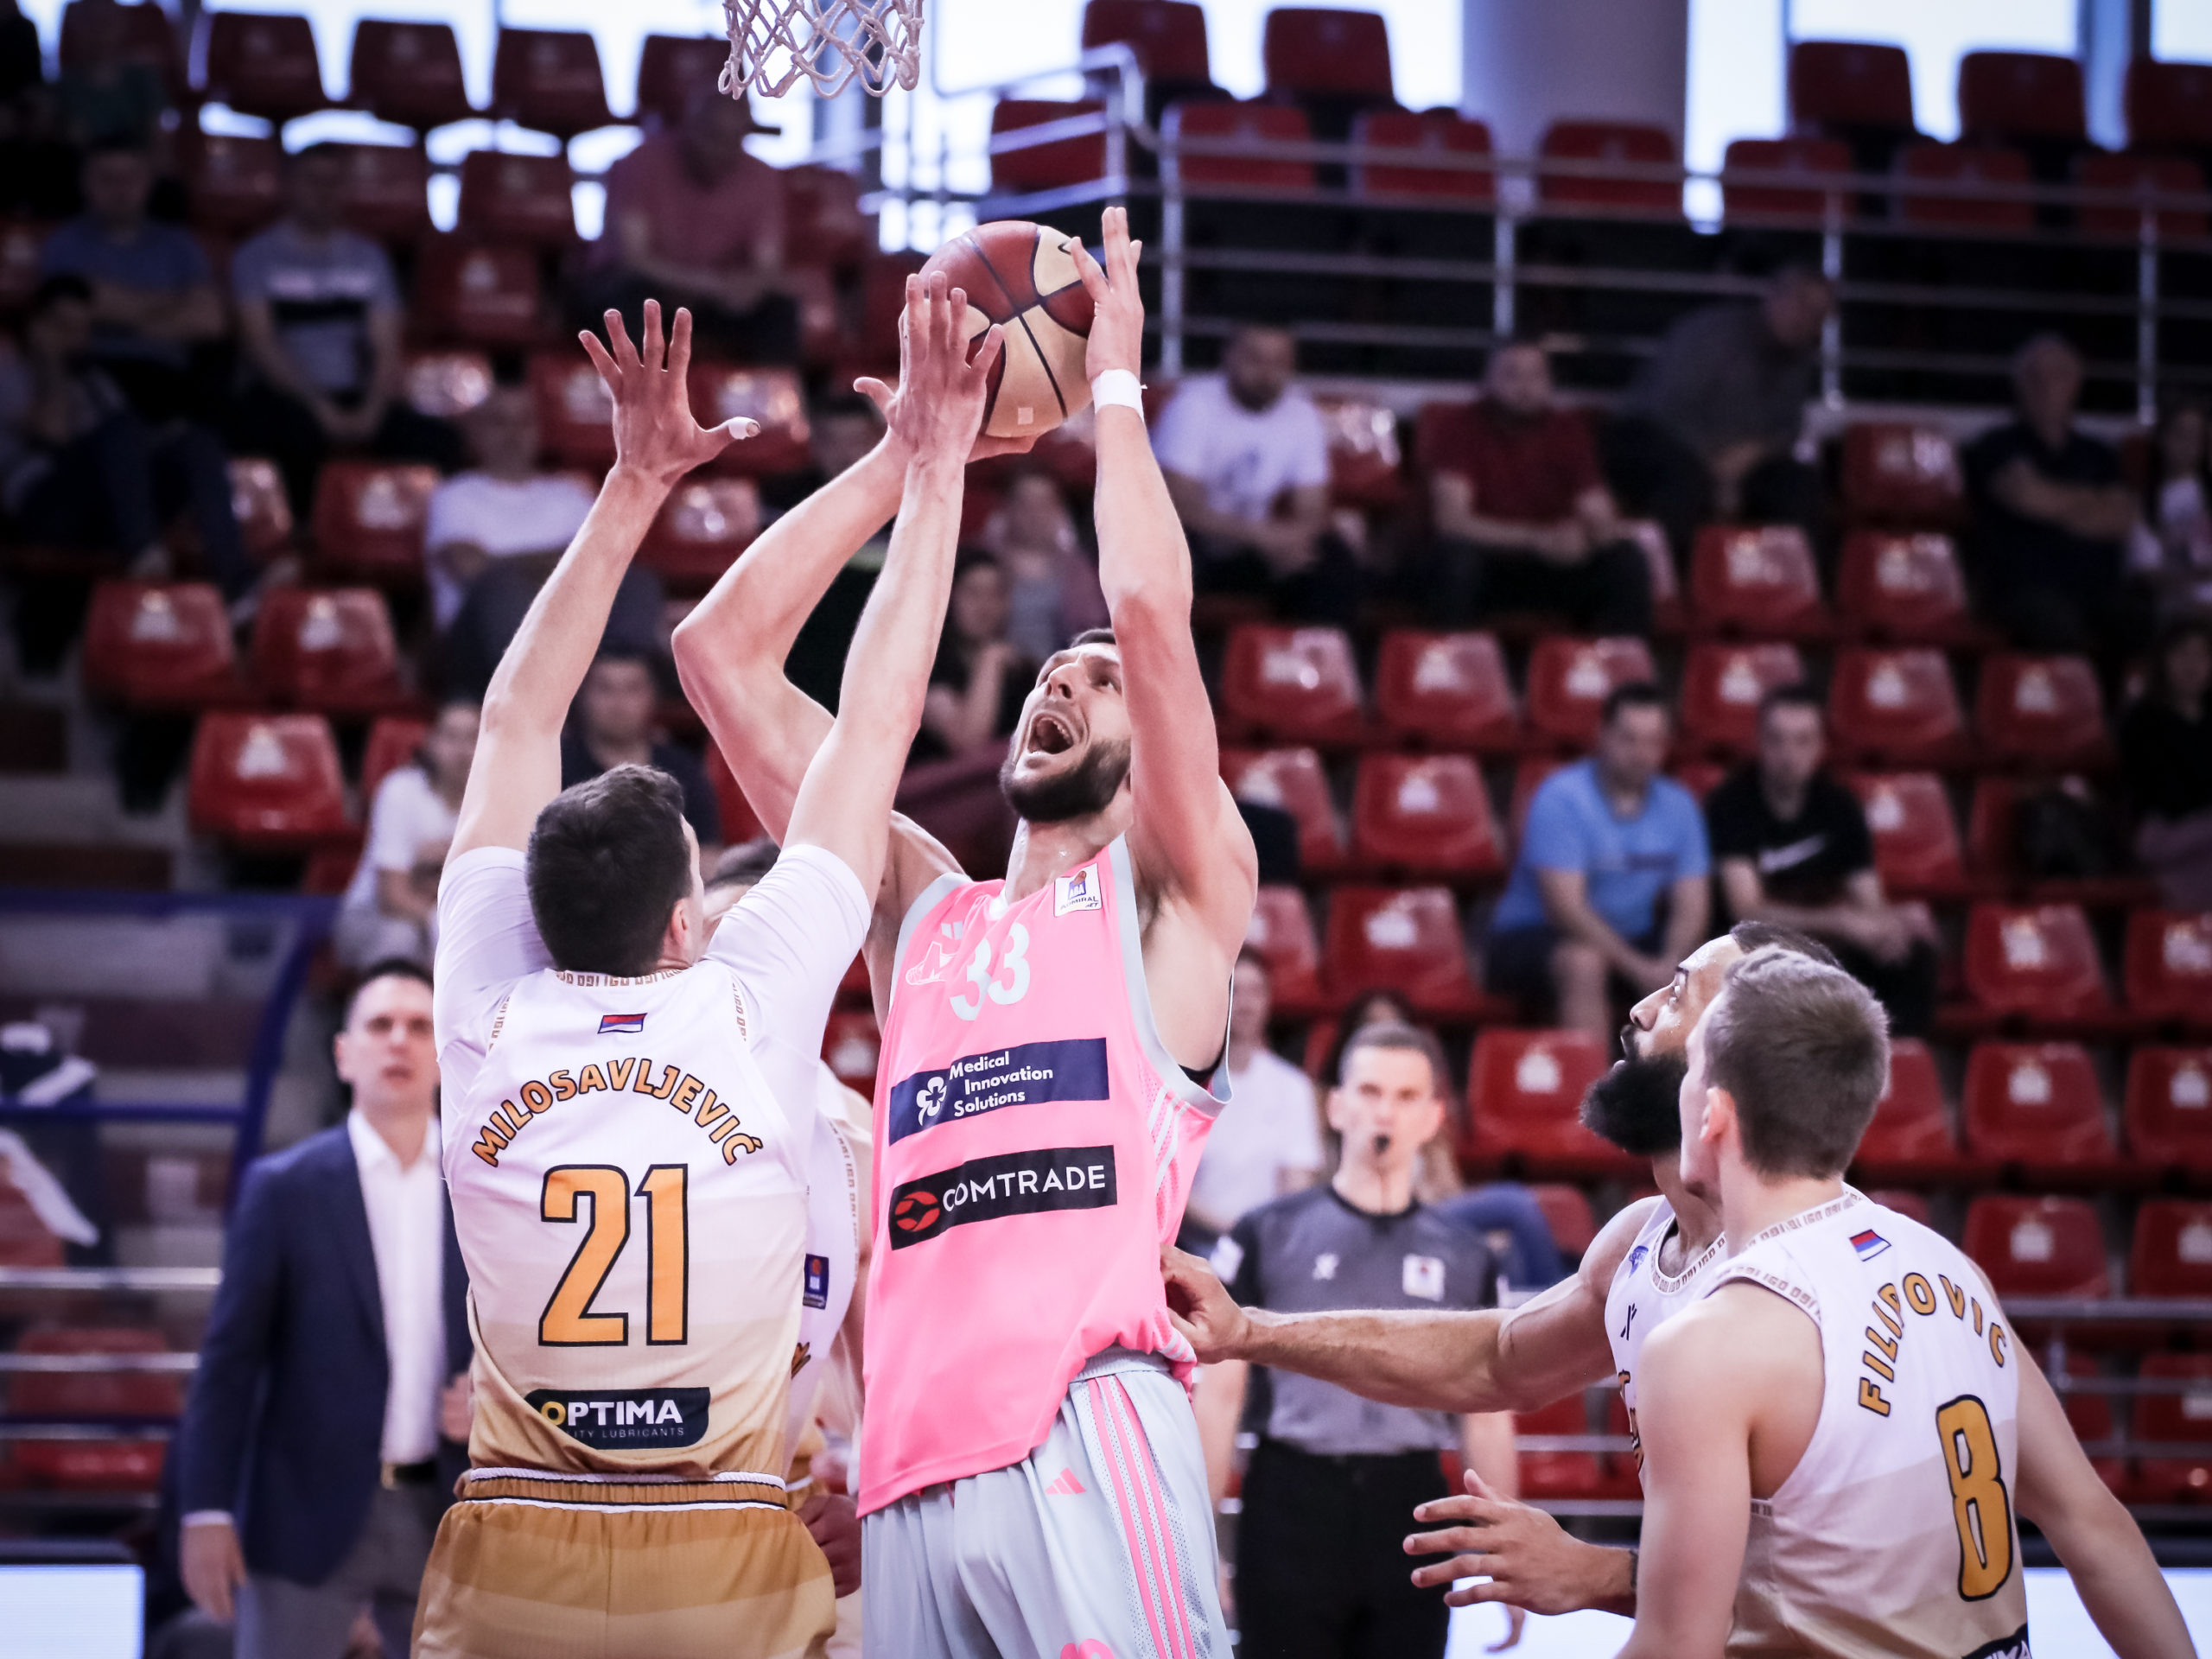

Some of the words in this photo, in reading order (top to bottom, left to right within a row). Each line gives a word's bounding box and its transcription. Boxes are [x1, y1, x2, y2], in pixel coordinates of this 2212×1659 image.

[950, 922, 1031, 1021] 33
[949, 1051, 1010, 1081] Medical
[964, 1065, 1054, 1095] Innovation
[472, 1058, 764, 1167] MILOSAVLJEVIĆ
[954, 1091, 1026, 1117] Solutions
[943, 1165, 1106, 1212] COMTRADE
[537, 1163, 688, 1346] 21
[541, 1399, 683, 1426] OPTIMA
[602, 1427, 685, 1439] LUBRICANTS
[1936, 1395, 2012, 1601] 8
